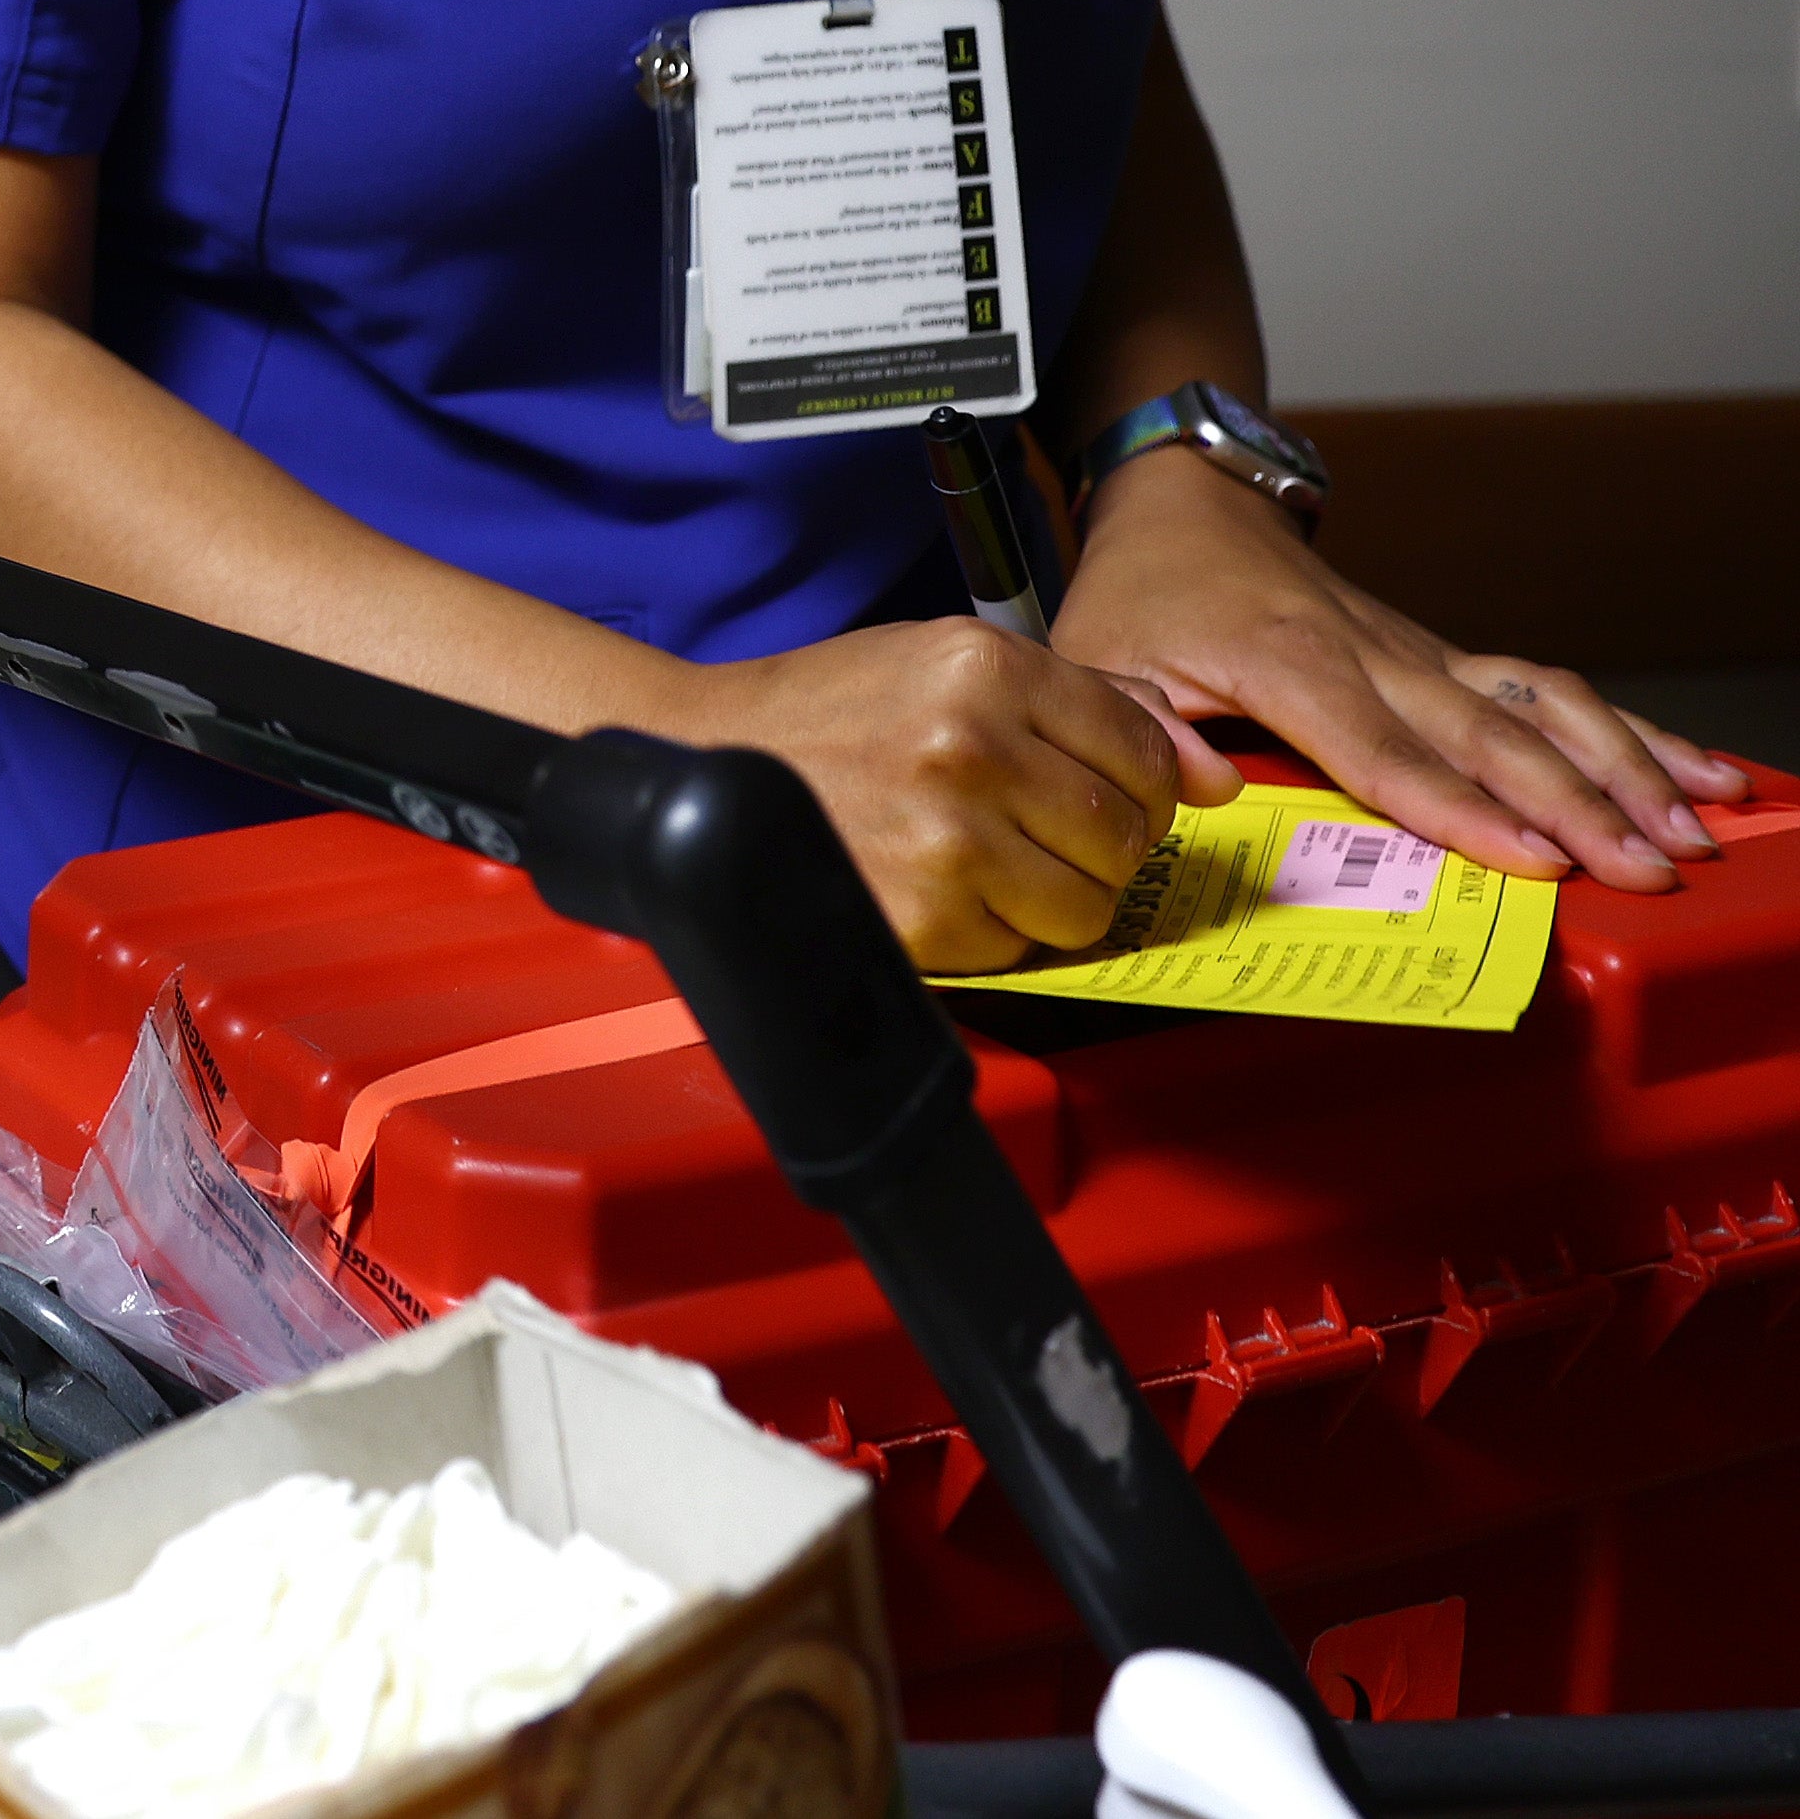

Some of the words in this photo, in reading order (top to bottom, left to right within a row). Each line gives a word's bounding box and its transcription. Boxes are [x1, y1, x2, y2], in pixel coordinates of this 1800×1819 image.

[950, 35, 972, 63] T
[956, 89, 976, 116] S
[960, 140, 982, 168] A
[965, 190, 985, 221] F
[969, 244, 989, 272] E
[973, 296, 993, 324] B
